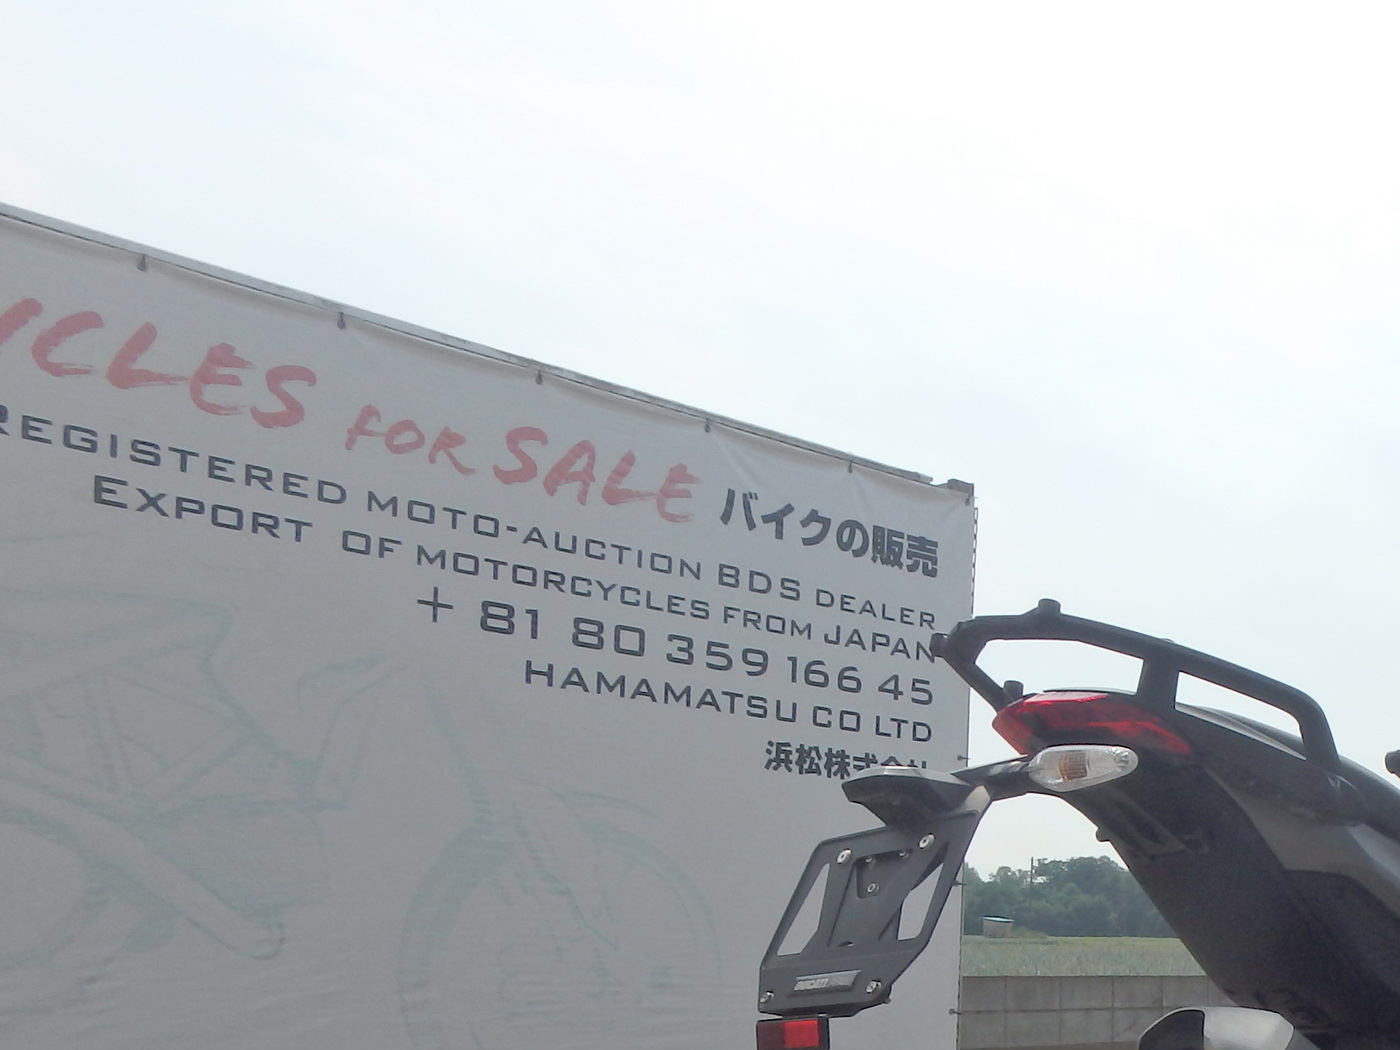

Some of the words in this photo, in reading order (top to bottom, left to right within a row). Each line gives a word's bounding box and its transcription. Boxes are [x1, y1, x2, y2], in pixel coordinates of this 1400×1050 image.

[493, 426, 700, 523] SALE
[94, 474, 313, 543] EXPORT
[342, 530, 402, 558] OF
[416, 544, 710, 620] MOTORCYCLES
[723, 605, 812, 640] FROM
[824, 624, 936, 663] JAPAN
[367, 490, 701, 580] MOTO-AUCTION
[718, 563, 801, 601] BDS
[816, 588, 936, 630] DEALER
[720, 488, 939, 578] バイクの販売
[480, 600, 539, 639] 81
[572, 617, 645, 658] 80
[666, 633, 769, 677] 359
[787, 656, 862, 694] 166
[877, 674, 934, 706] 45
[525, 659, 797, 723] HAMAMATSU
[812, 705, 861, 733] CO
[875, 715, 932, 743] LTD
